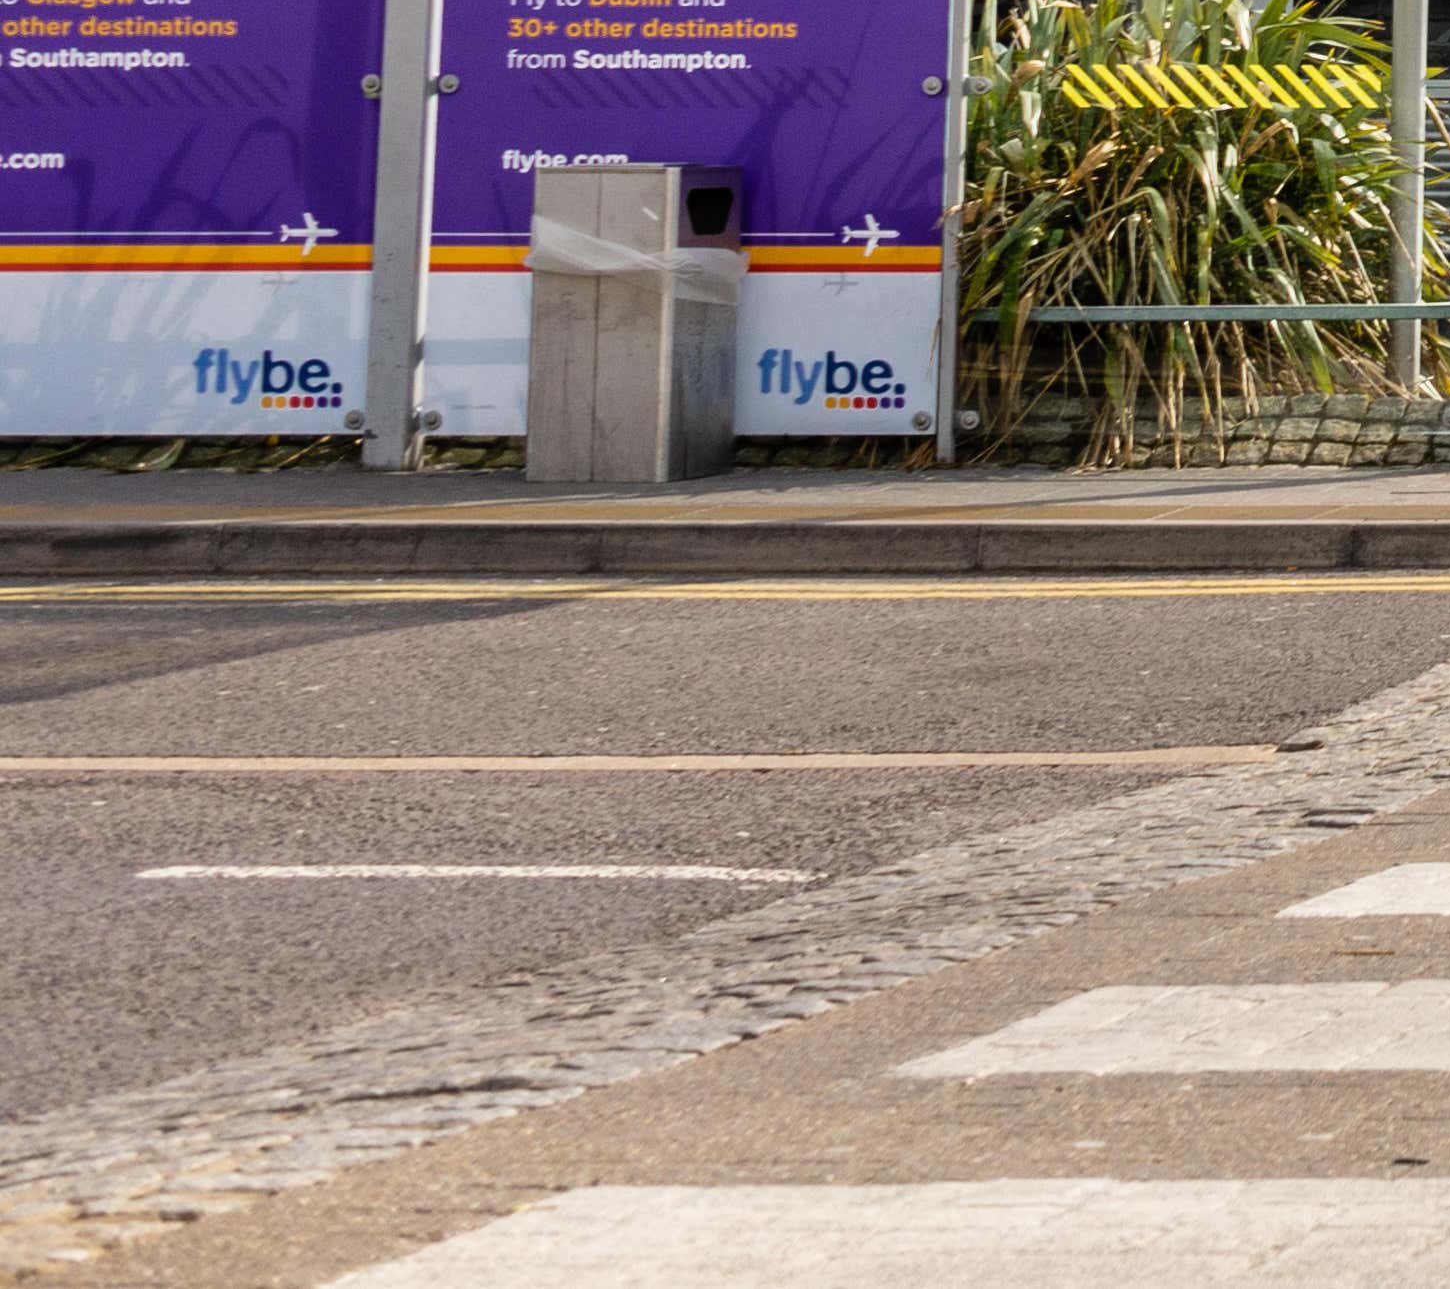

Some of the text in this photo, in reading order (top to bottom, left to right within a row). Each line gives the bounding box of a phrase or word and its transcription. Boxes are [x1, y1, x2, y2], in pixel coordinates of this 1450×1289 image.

[2, 16, 237, 36] other destinations
[508, 19, 797, 38] 30+ other destinations
[10, 48, 191, 71] Southampton.
[507, 49, 752, 72] from Southampton.
[501, 150, 629, 173] flybe.com
